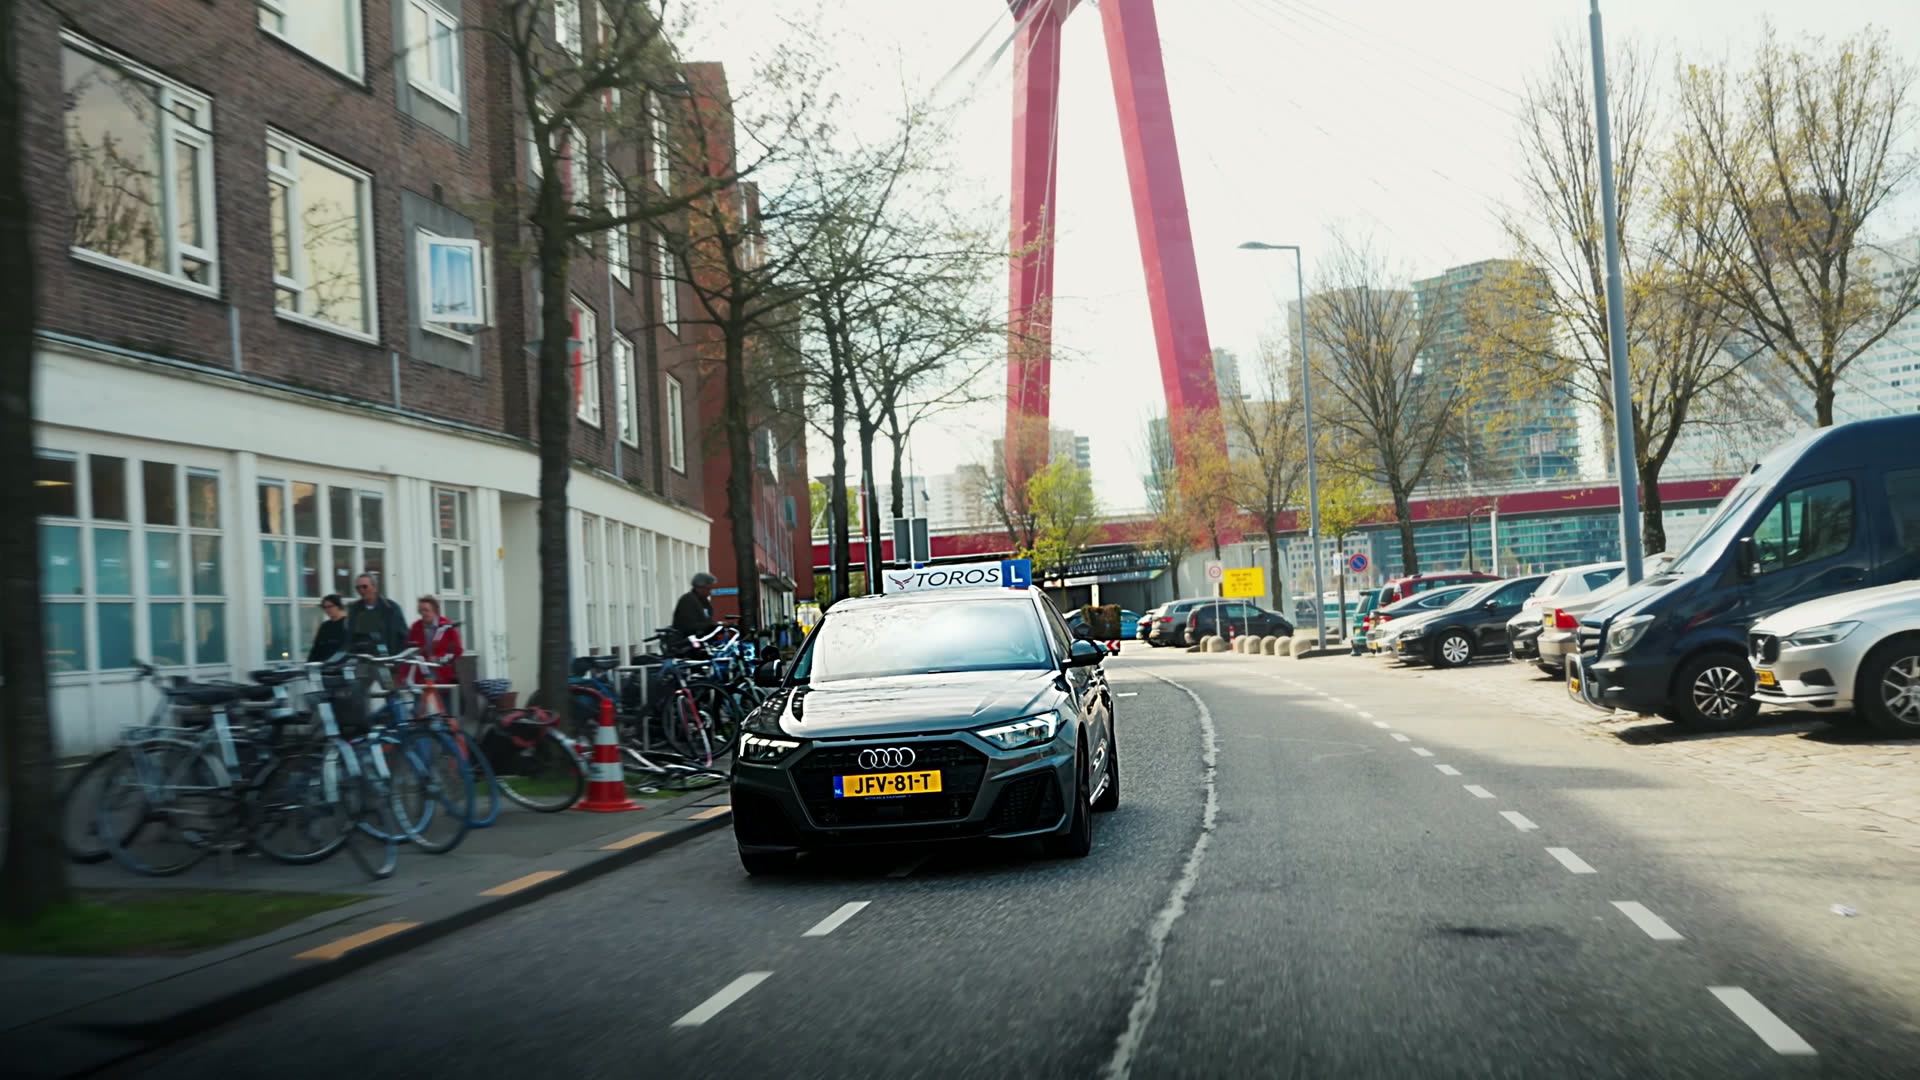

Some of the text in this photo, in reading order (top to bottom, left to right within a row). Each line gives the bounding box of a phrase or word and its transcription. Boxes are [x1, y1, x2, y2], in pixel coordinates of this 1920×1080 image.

[915, 568, 1000, 588] TOROS
[1010, 565, 1024, 583] L
[854, 773, 932, 794] JFV-81-T
